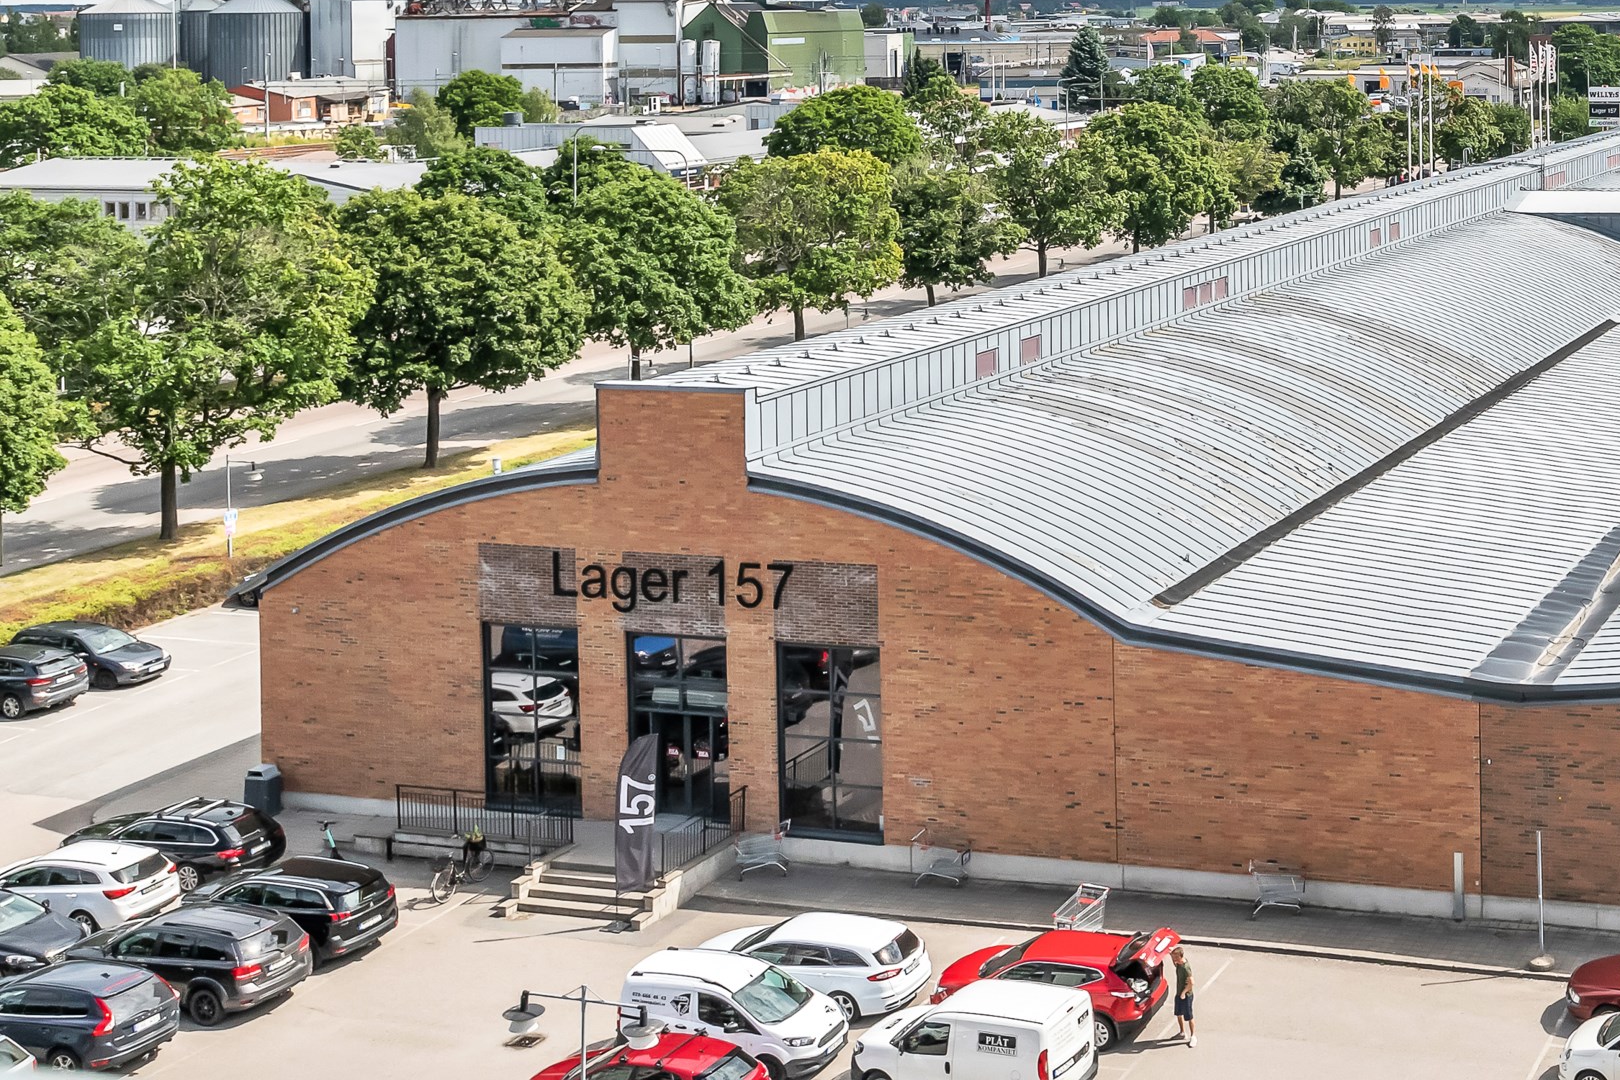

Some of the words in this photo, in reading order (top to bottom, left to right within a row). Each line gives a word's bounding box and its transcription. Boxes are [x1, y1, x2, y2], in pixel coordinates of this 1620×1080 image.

[1591, 107, 1606, 115] Lager
[552, 551, 688, 613] Lager
[708, 559, 794, 610] 157
[985, 1035, 1009, 1047] PLÅT
